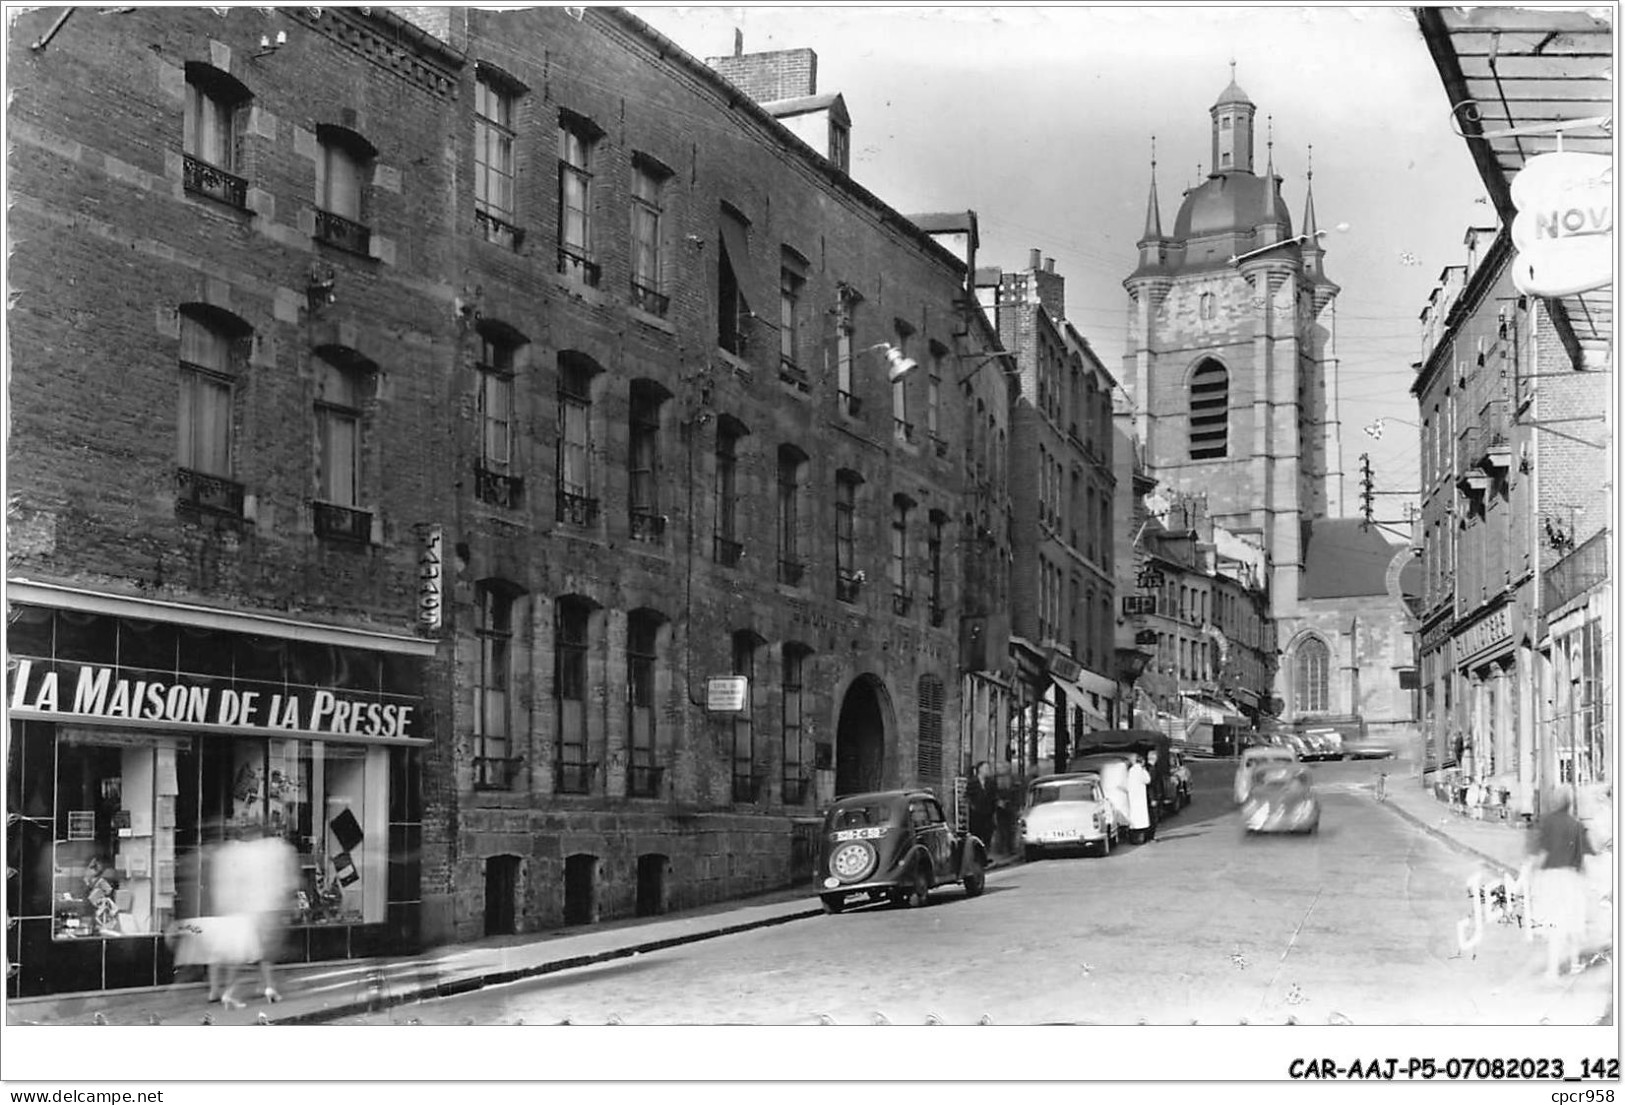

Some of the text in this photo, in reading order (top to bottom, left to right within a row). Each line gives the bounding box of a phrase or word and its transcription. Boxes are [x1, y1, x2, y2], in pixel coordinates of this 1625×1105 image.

[11, 659, 414, 739] LA MAISON DE LA PRESSE
